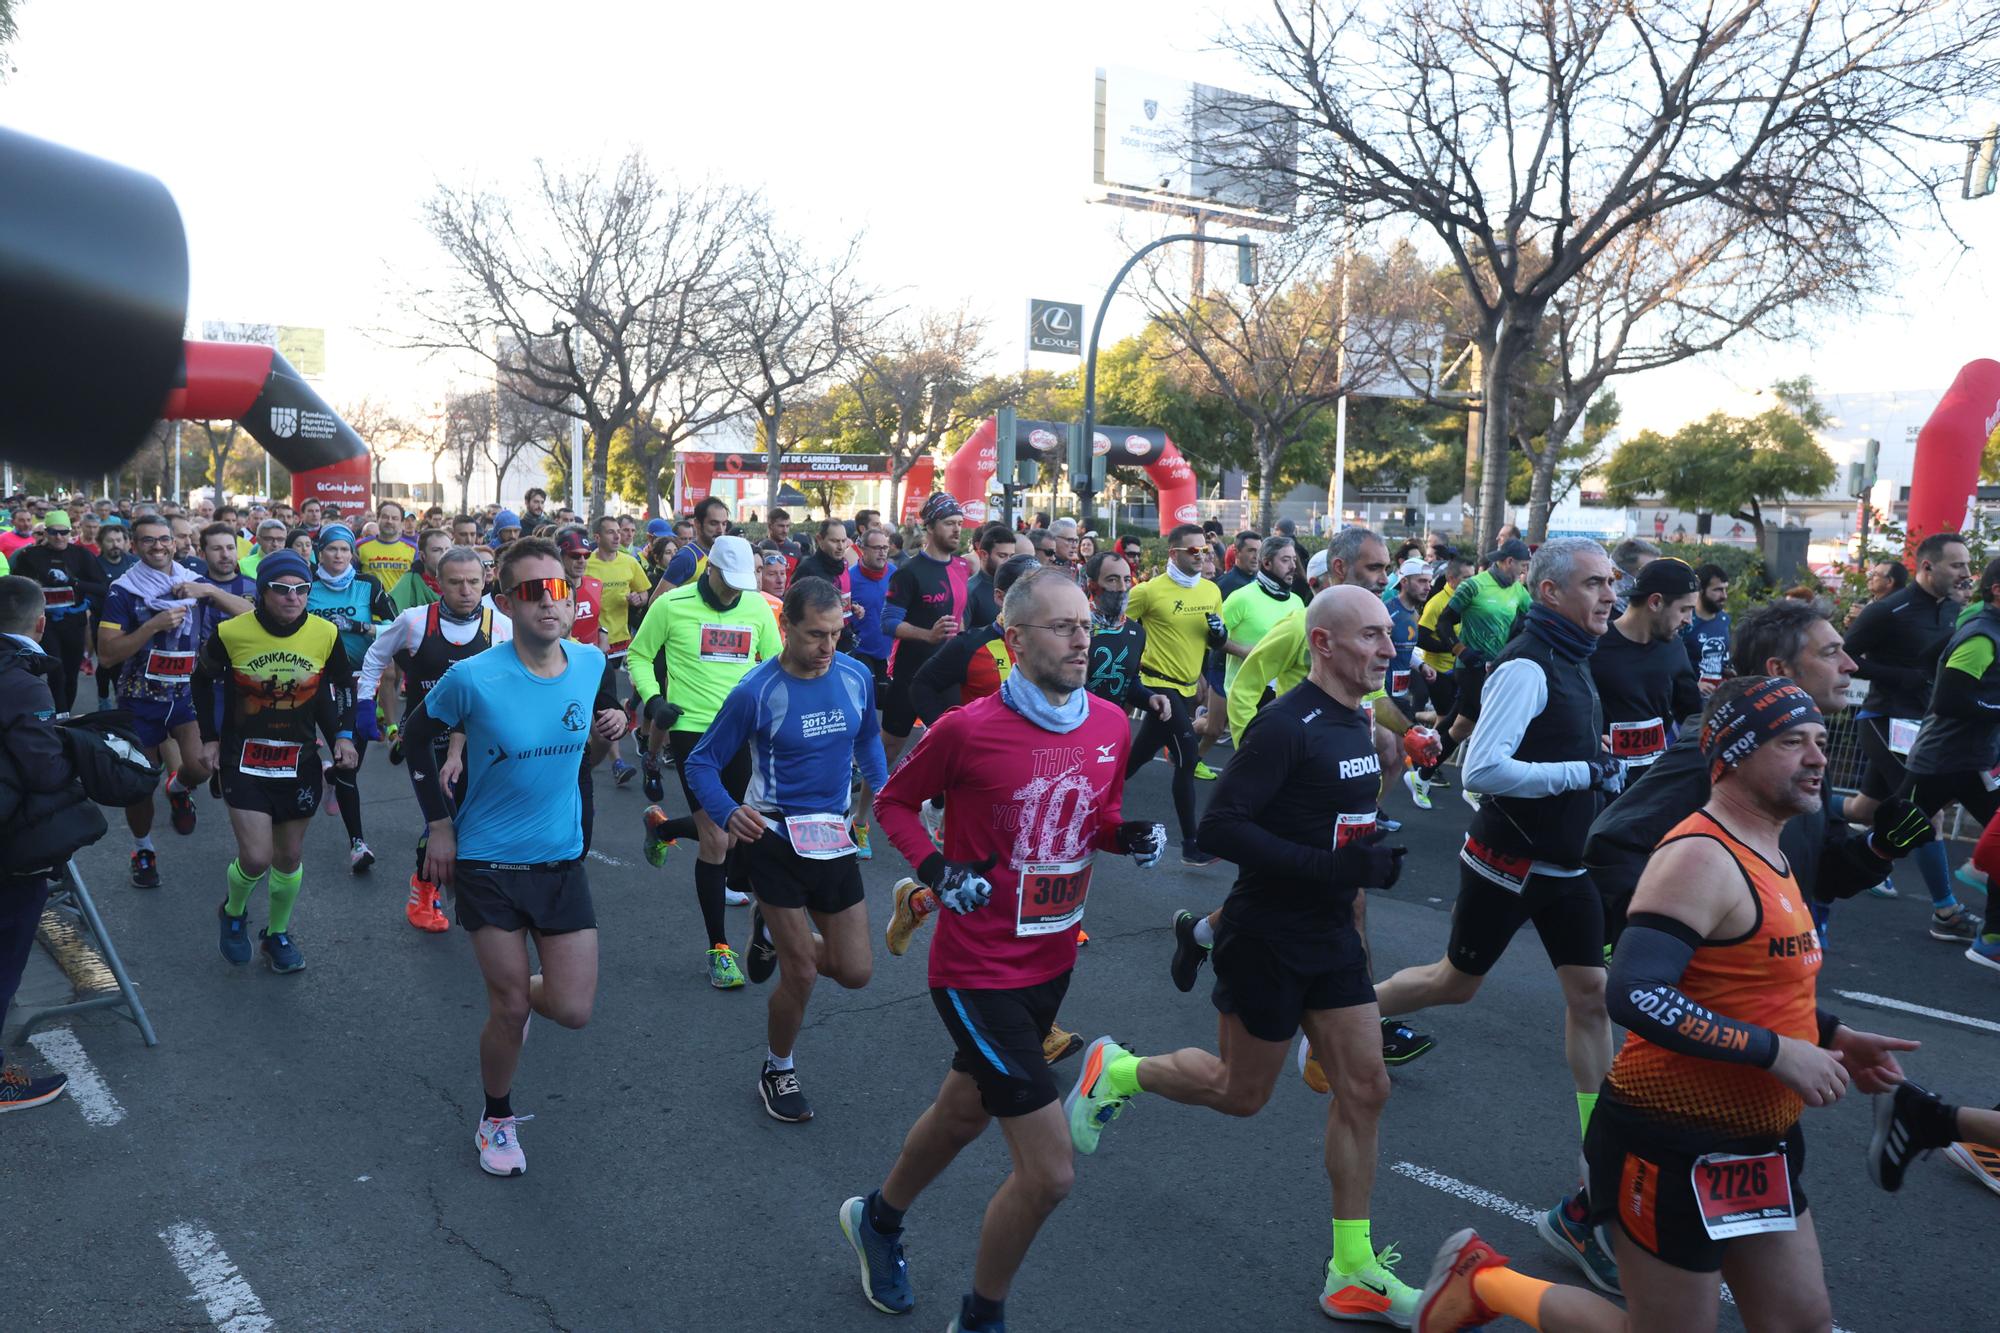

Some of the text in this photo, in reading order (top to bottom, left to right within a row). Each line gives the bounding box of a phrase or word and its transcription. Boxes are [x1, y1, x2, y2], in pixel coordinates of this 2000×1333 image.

[1034, 336, 1080, 348] LEXUS
[300, 425, 337, 434] Municipal
[791, 455, 801, 464] DE
[802, 456, 841, 465] CARRERES
[368, 561, 408, 570] runners
[708, 630, 743, 648] 3241
[157, 657, 186, 671] 2713
[246, 651, 314, 673] TRENKACAMES
[802, 716, 827, 729] 2013
[1620, 728, 1659, 749] 3280
[1722, 730, 1757, 763] STOP
[1031, 746, 1086, 777] THIS
[1629, 988, 1683, 1027] STOP
[1677, 1014, 1750, 1052] NEVER
[1706, 1160, 1769, 1201] 2726
